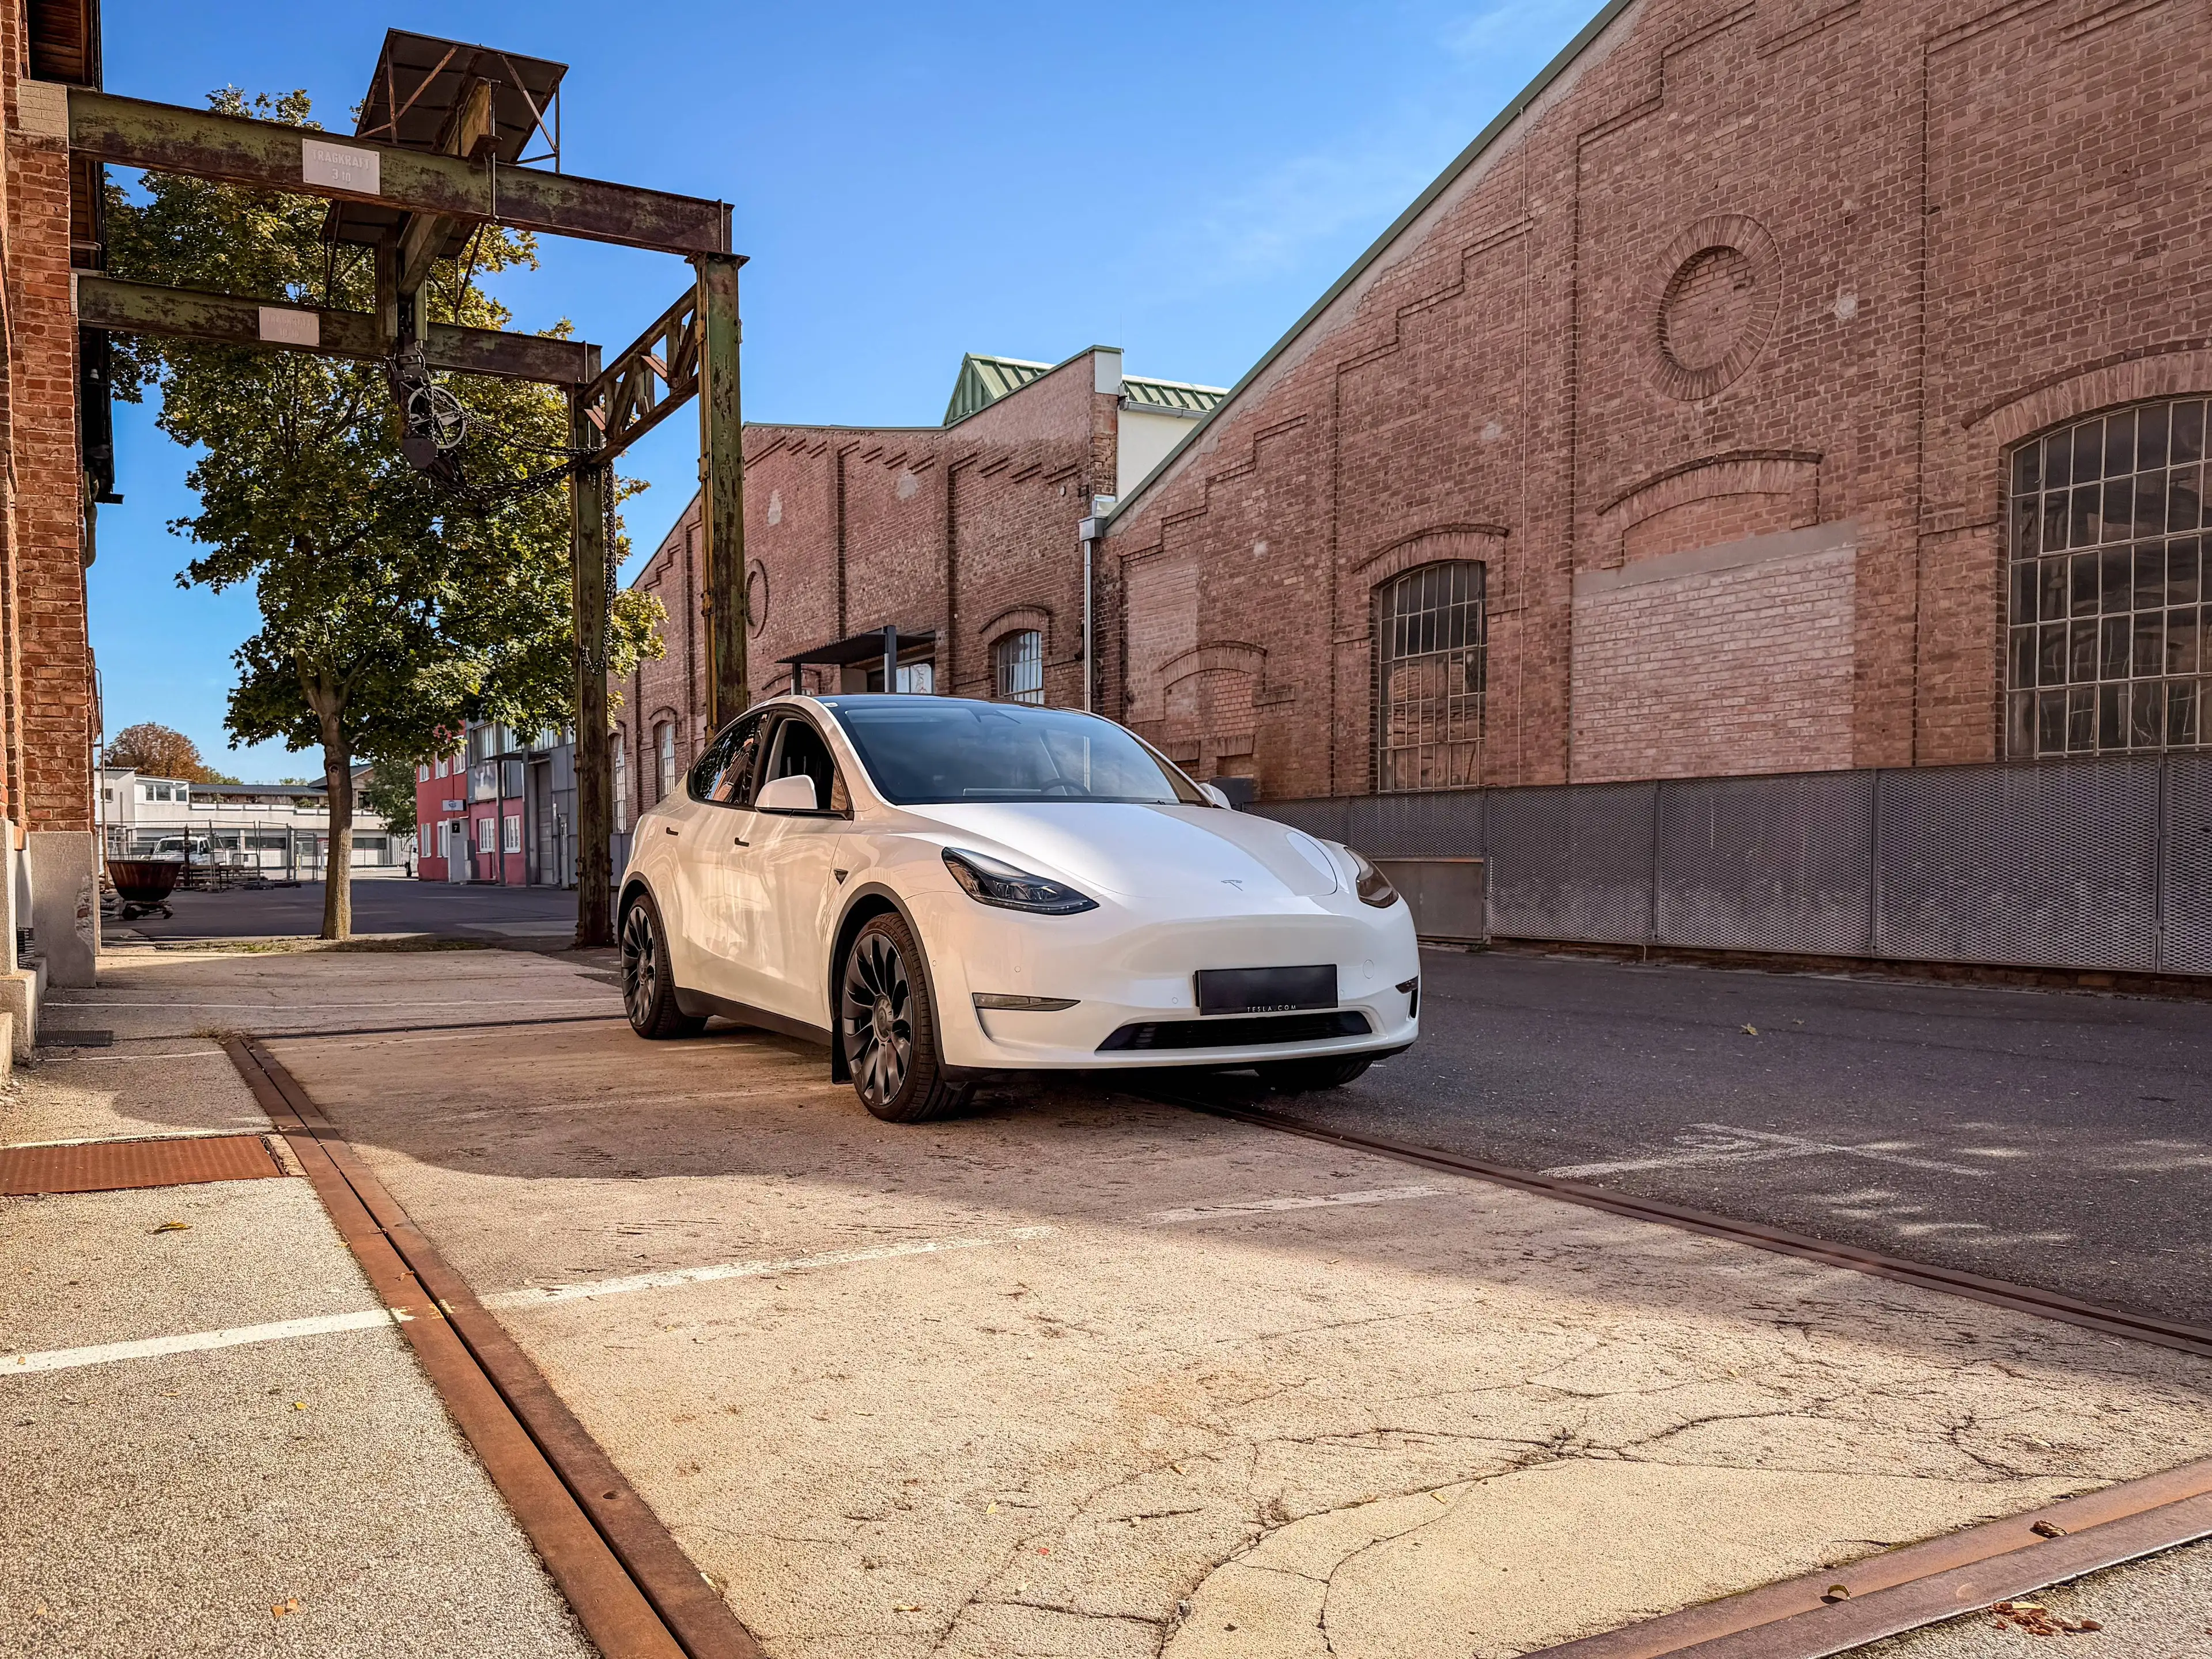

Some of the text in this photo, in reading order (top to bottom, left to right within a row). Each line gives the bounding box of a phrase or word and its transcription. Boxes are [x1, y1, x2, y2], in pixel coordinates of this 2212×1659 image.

[312, 149, 370, 169] TRAGKRAFT
[332, 168, 338, 179] 3
[1247, 1005, 1296, 1013] TESLA.COM
